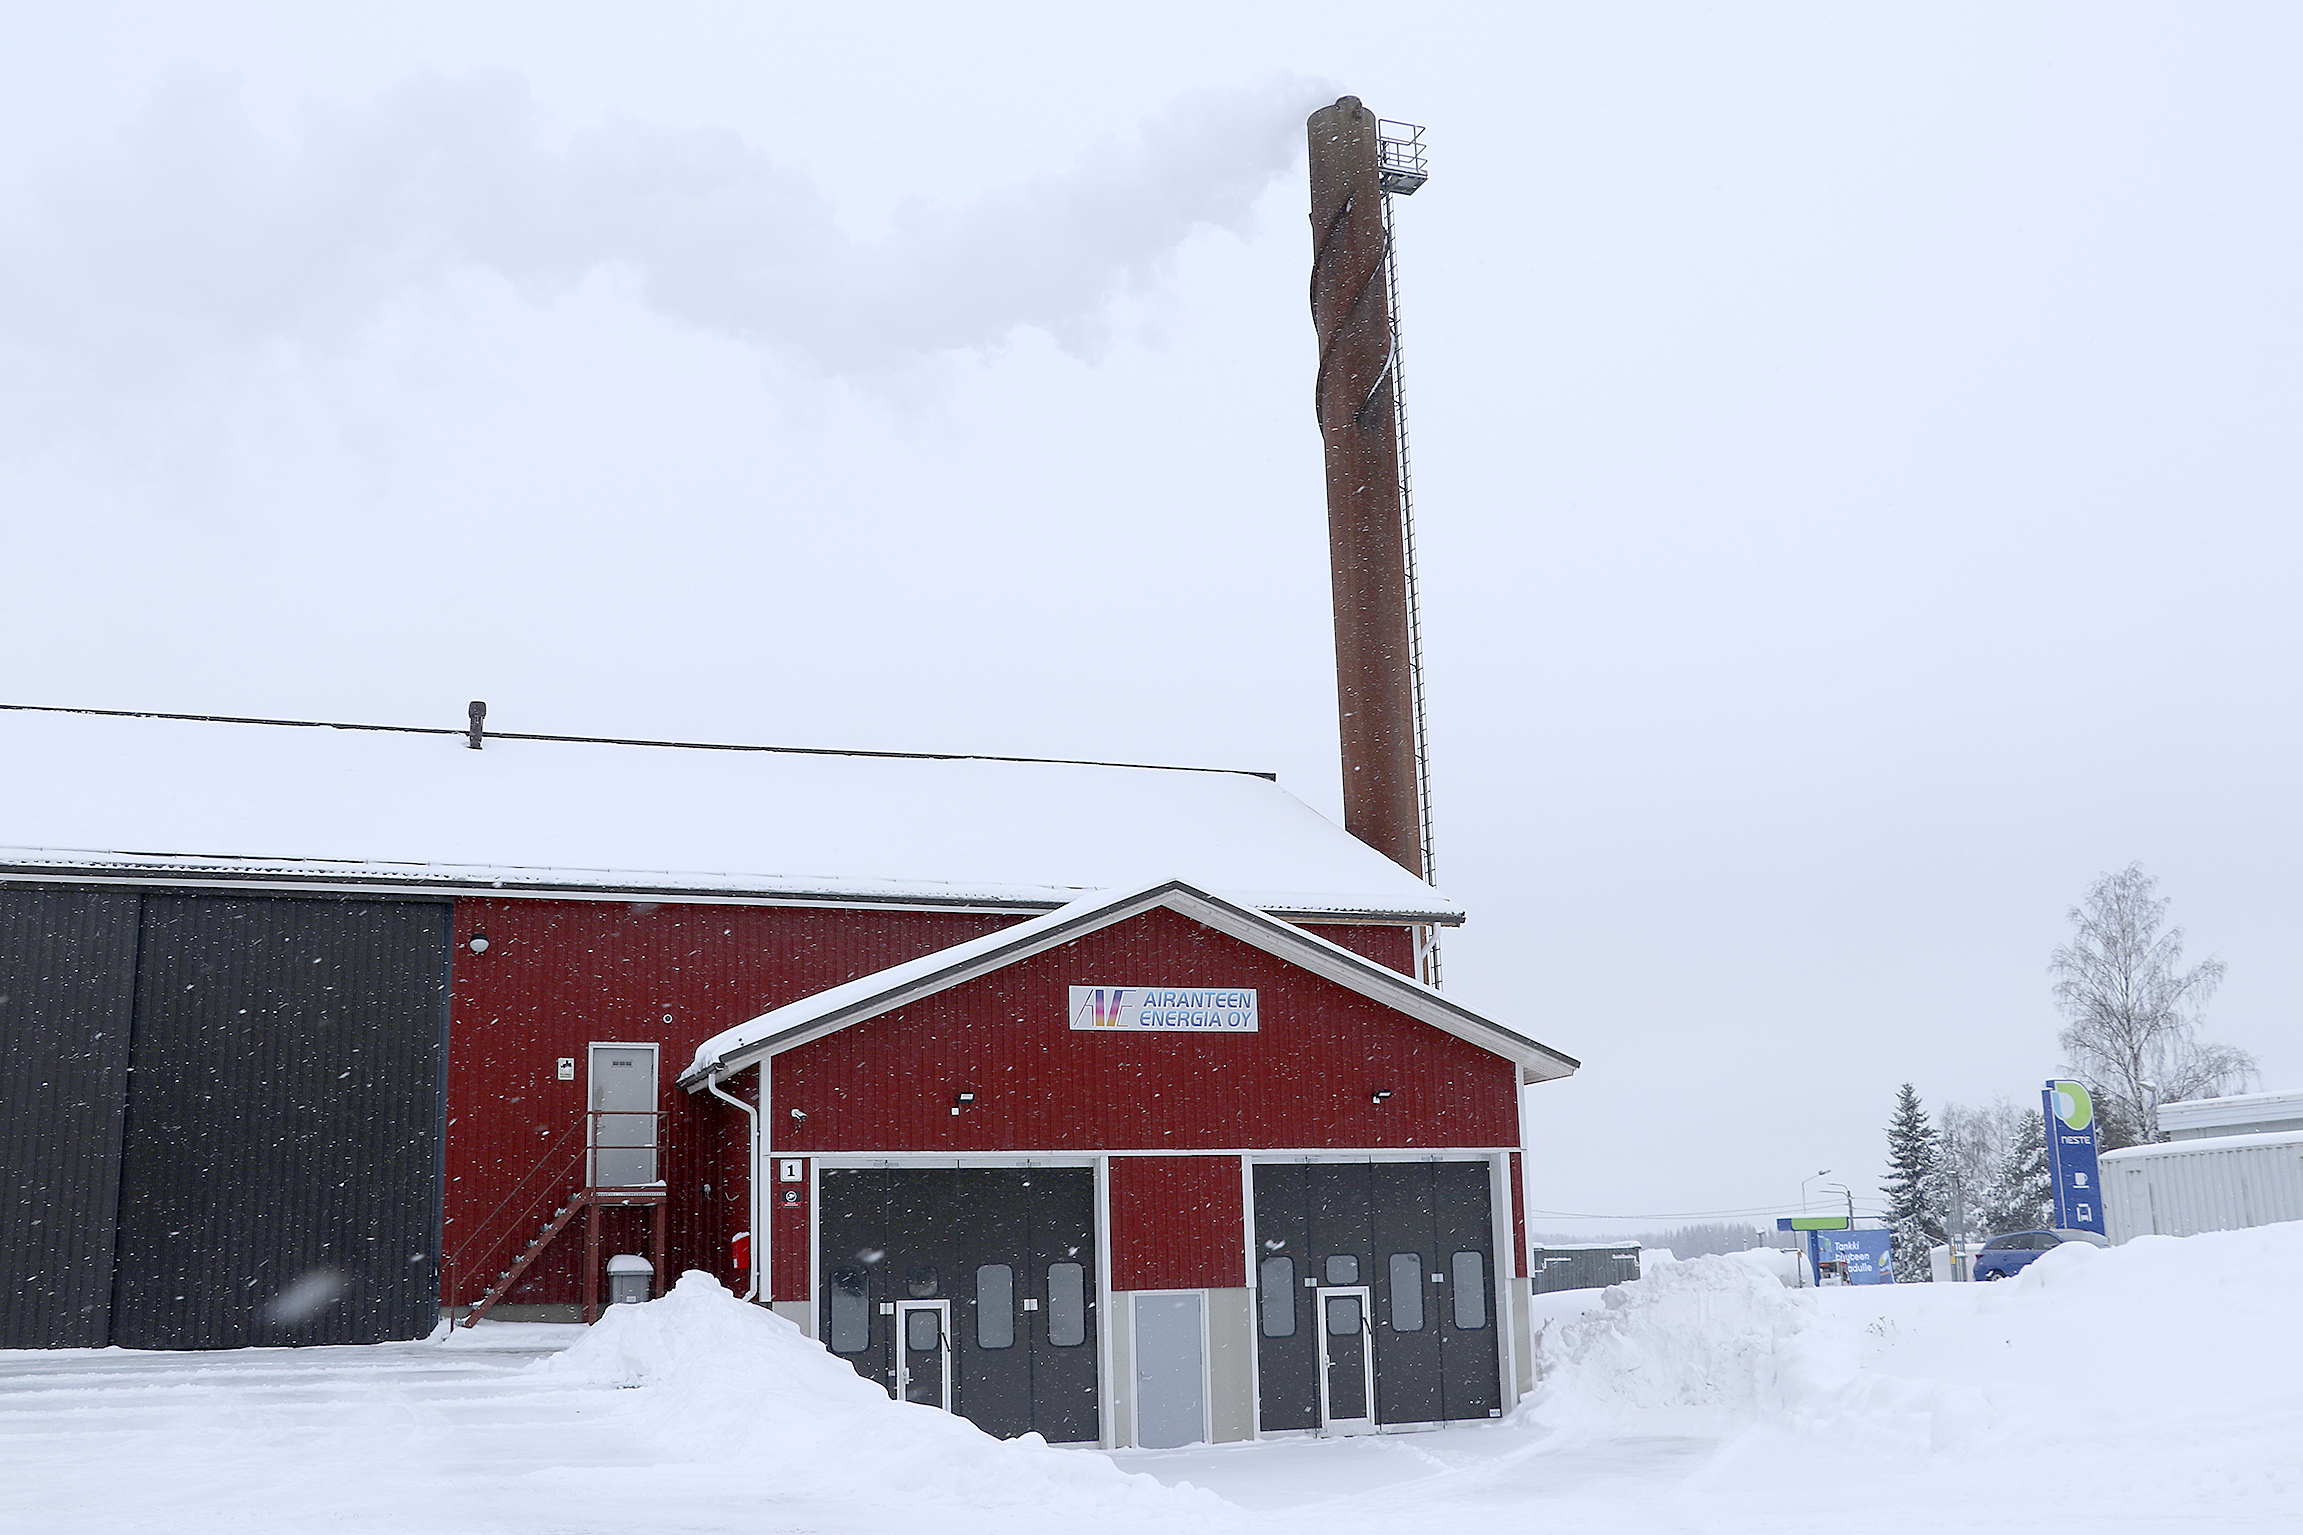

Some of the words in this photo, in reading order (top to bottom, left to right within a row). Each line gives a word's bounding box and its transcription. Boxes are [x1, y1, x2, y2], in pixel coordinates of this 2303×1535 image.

[1143, 991, 1251, 1008] AIRANTEEN
[1139, 1010, 1222, 1027] ENERGIA
[1227, 1011, 1253, 1028] OY
[2061, 1136, 2091, 1144] NESTE
[788, 1164, 796, 1177] 1
[1835, 1241, 1859, 1250] Tankki
